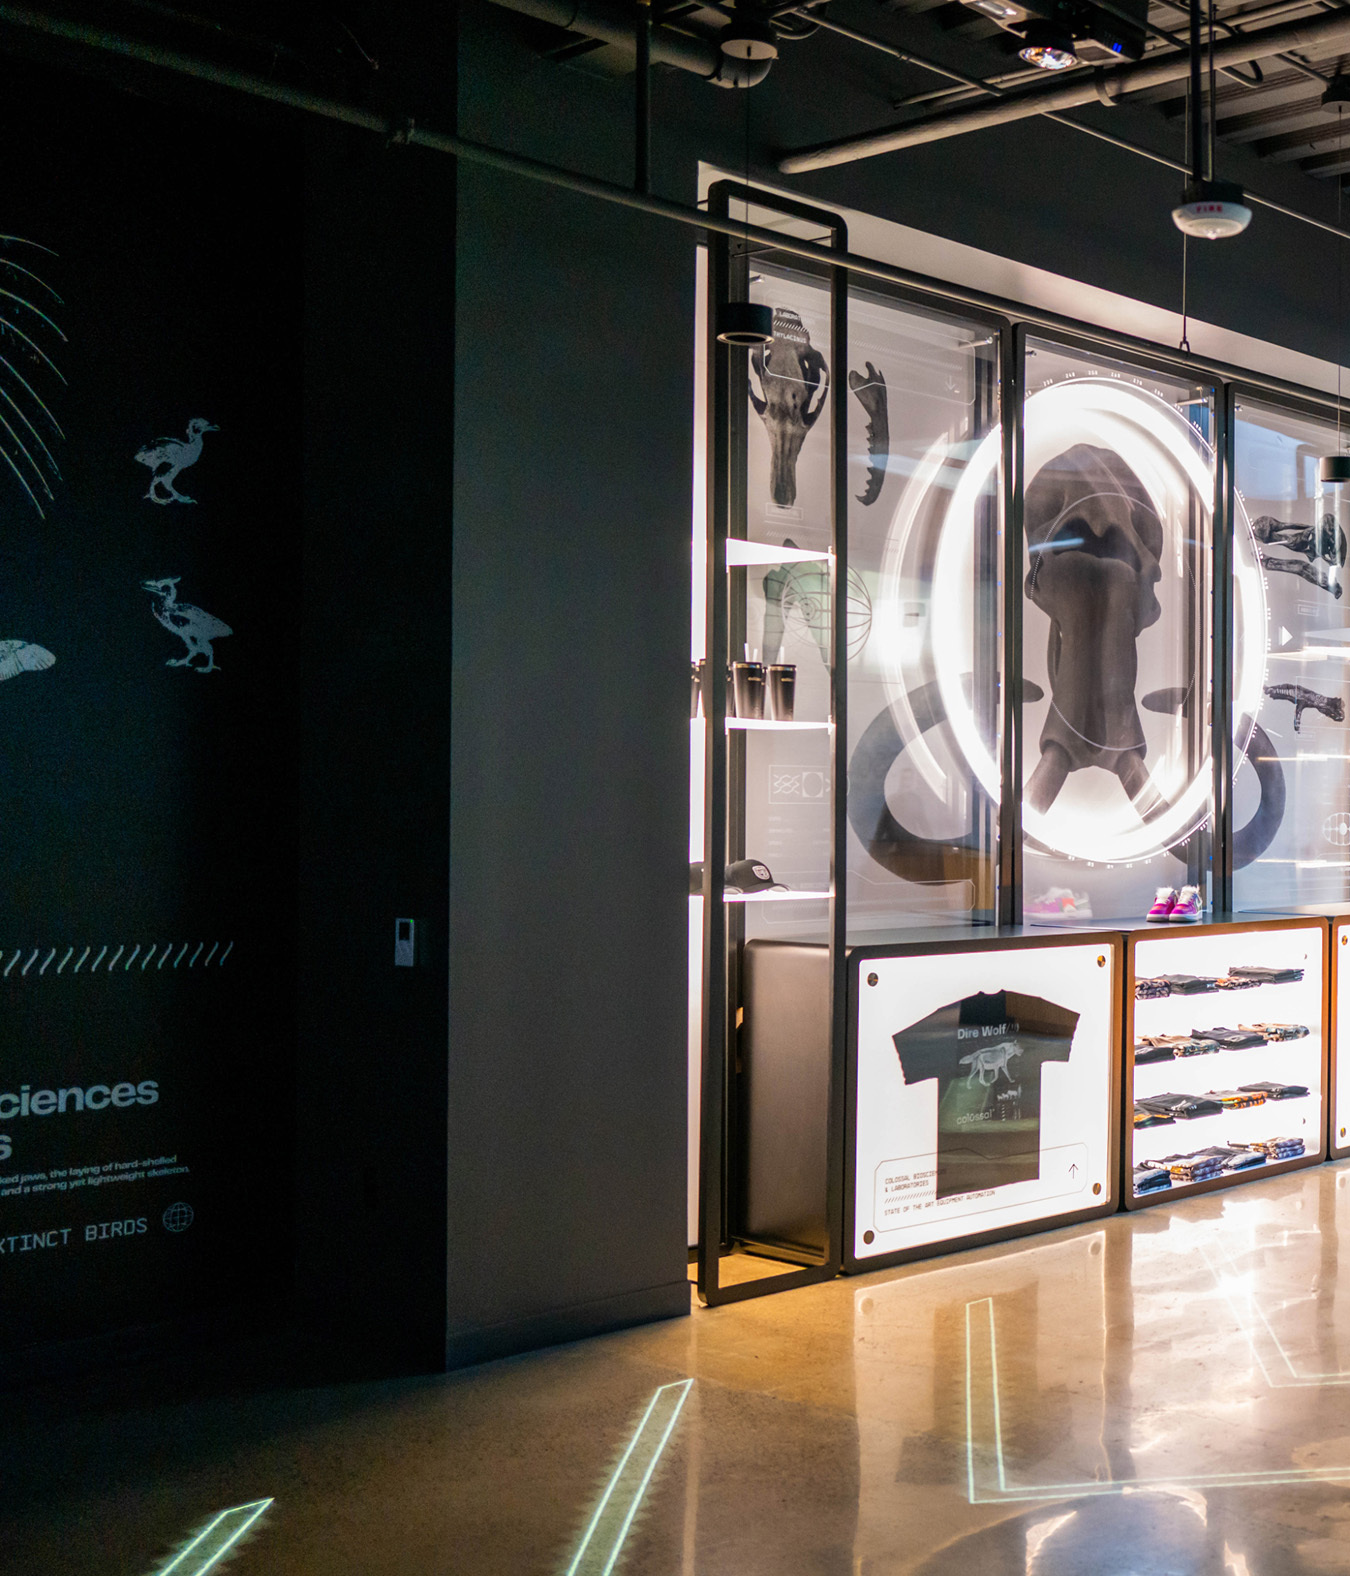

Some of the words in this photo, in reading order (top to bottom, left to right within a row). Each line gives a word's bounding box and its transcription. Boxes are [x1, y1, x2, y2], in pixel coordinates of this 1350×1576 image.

[957, 1028, 979, 1040] Dire
[0, 1080, 159, 1119] ciences
[49, 1169, 68, 1178] the
[69, 1164, 100, 1177] laying
[102, 1162, 114, 1172] of
[115, 1154, 178, 1171] hard-shelled
[1, 1185, 22, 1196] and
[32, 1180, 67, 1192] strong
[68, 1178, 86, 1190] yet
[88, 1170, 145, 1187] lightweight
[885, 1175, 910, 1184] COLOSSAL
[891, 1180, 929, 1192] LABORATORIES
[884, 1207, 900, 1216] STATE
[903, 1205, 910, 1213] OF
[913, 1203, 922, 1211] THE
[937, 1196, 964, 1206] EQUIPMENT
[966, 1190, 995, 1200] AUTOMATION
[85, 1217, 149, 1241] BIRDS
